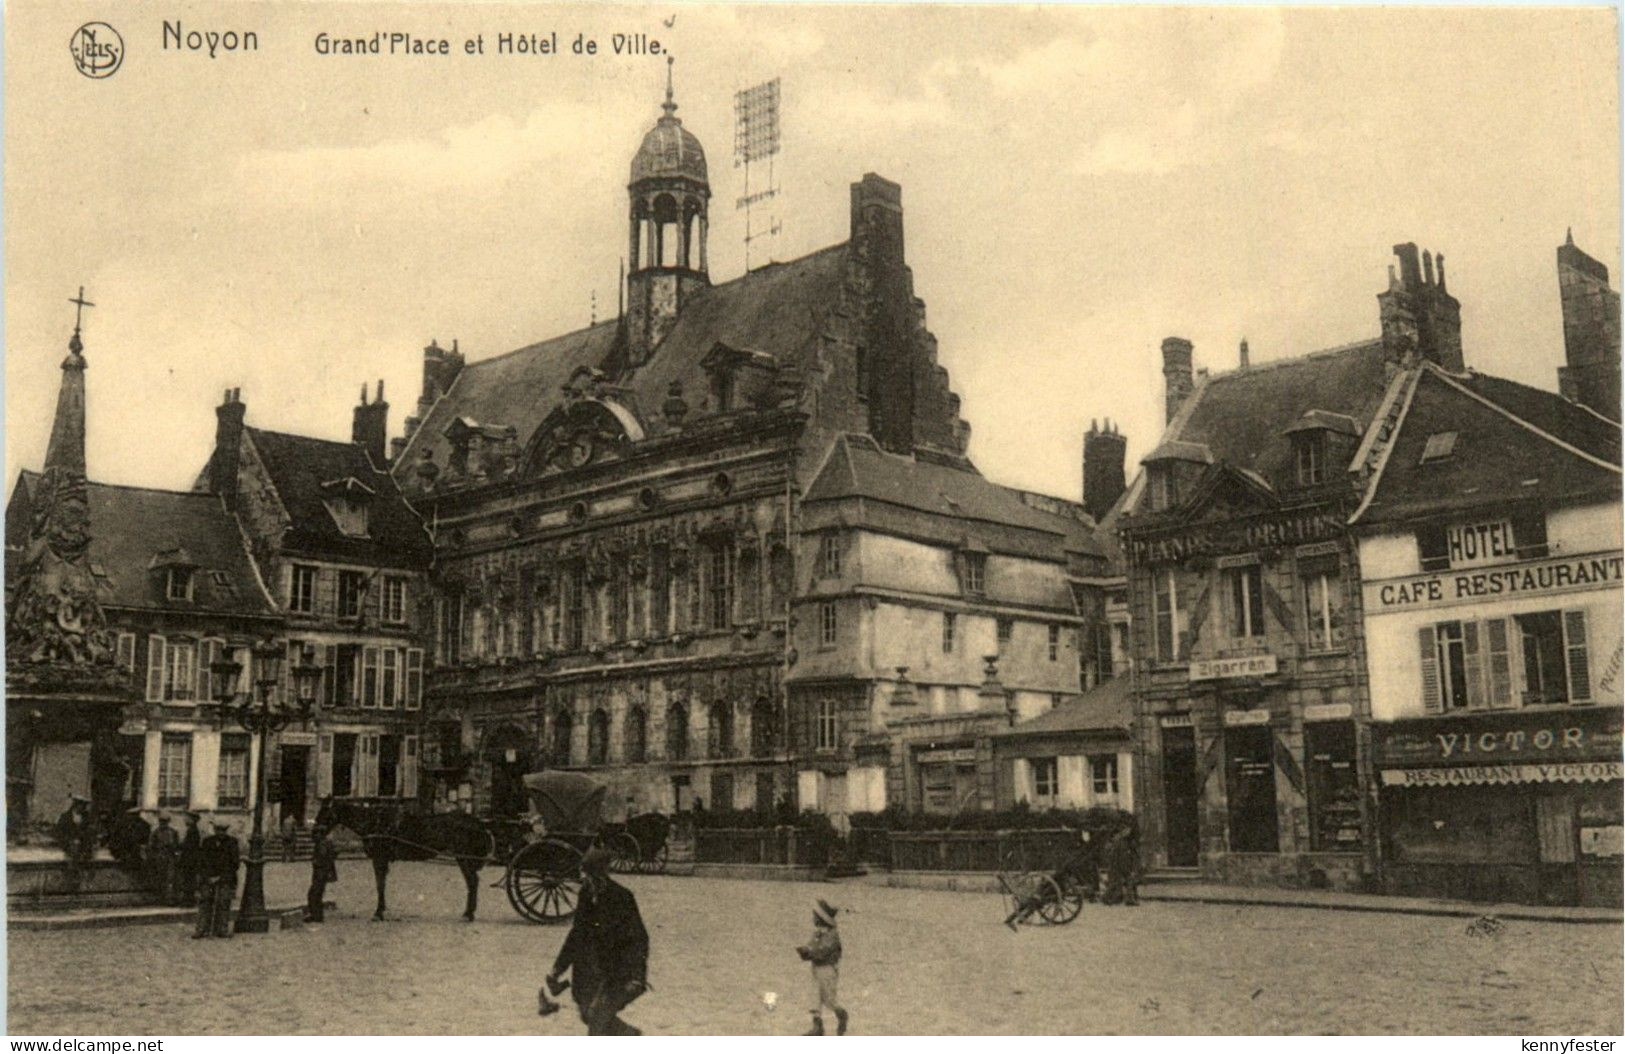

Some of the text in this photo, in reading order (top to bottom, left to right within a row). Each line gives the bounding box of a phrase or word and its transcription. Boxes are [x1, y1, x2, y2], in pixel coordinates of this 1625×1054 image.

[1381, 558, 1623, 605] CAFÉ RESTAURANT
[1437, 727, 1583, 757] VICTOR
[1404, 764, 1620, 783] RESTAURANT VICTOR
